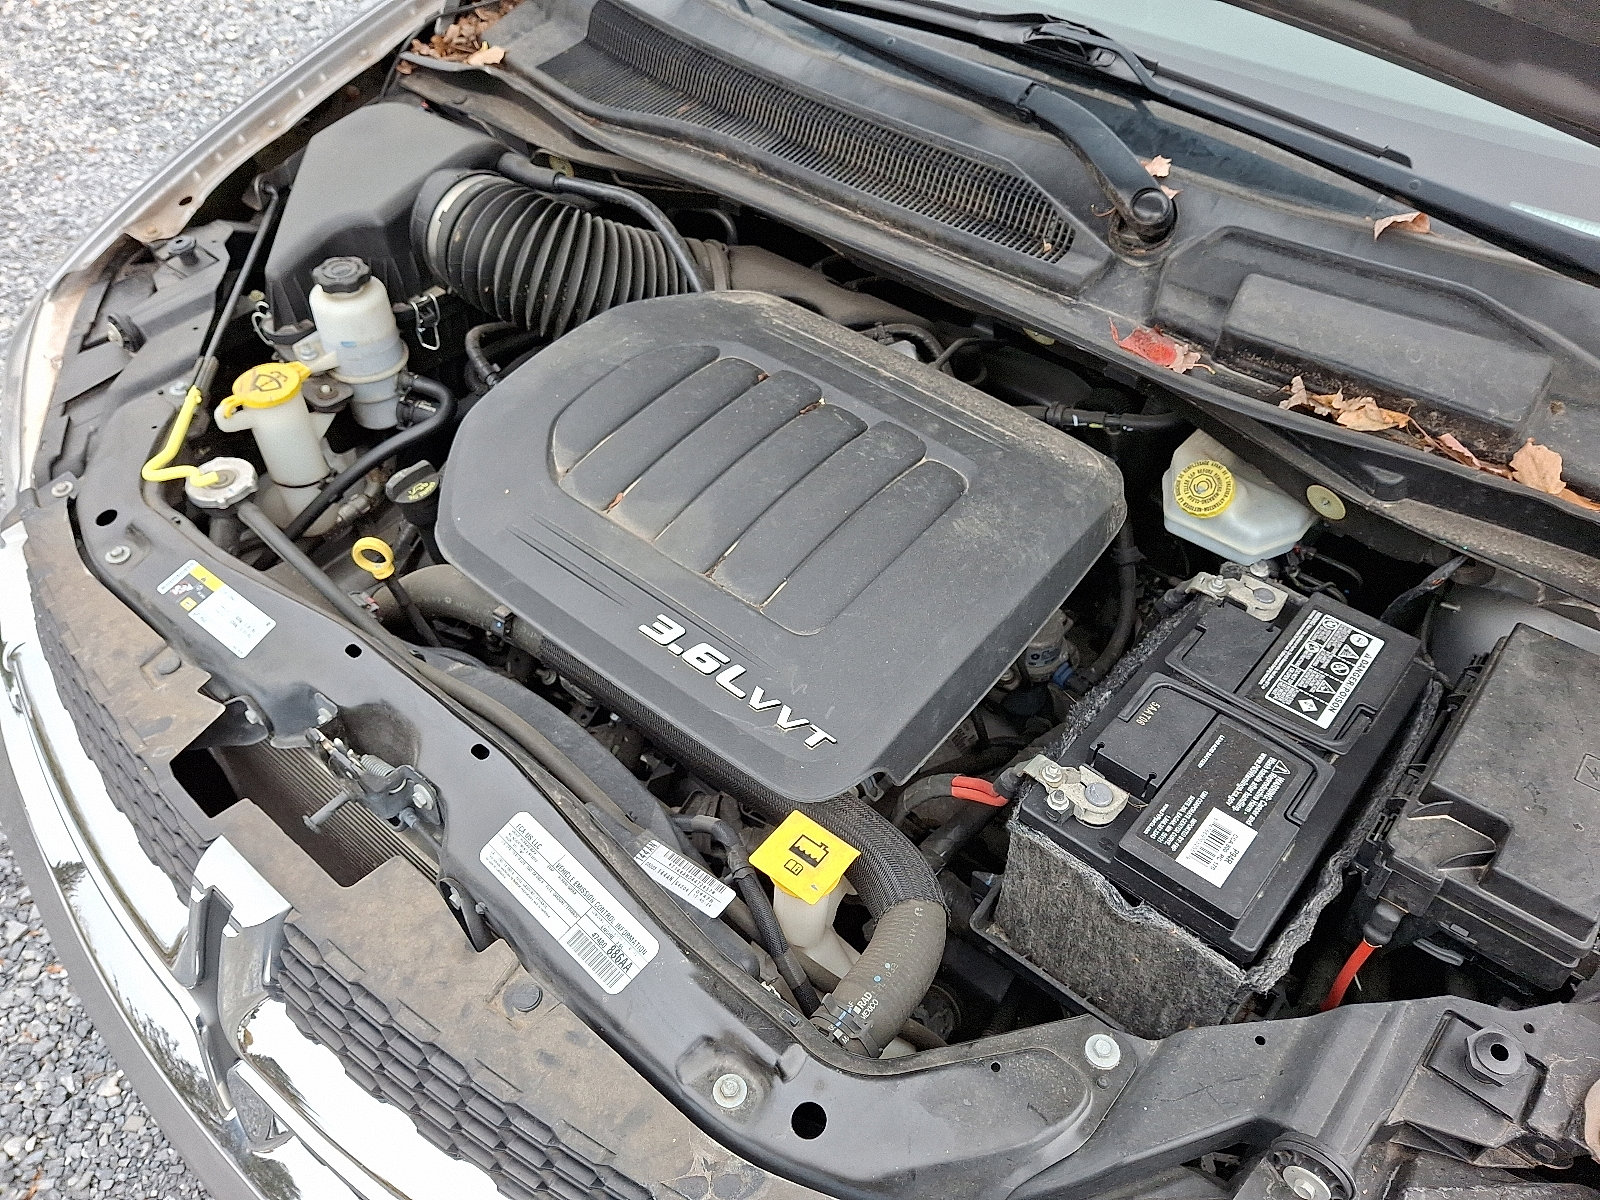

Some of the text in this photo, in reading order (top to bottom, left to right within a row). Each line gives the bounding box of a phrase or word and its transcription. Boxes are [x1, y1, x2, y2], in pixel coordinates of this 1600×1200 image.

[638, 613, 838, 750] 3.6L VVT
[555, 863, 575, 883] VEHICLE
[573, 881, 596, 904] EMISSION
[594, 901, 617, 925] CONTROL
[615, 922, 648, 956] INFORMATION
[606, 945, 634, 973] 886AA
[858, 991, 873, 1010] RAD
